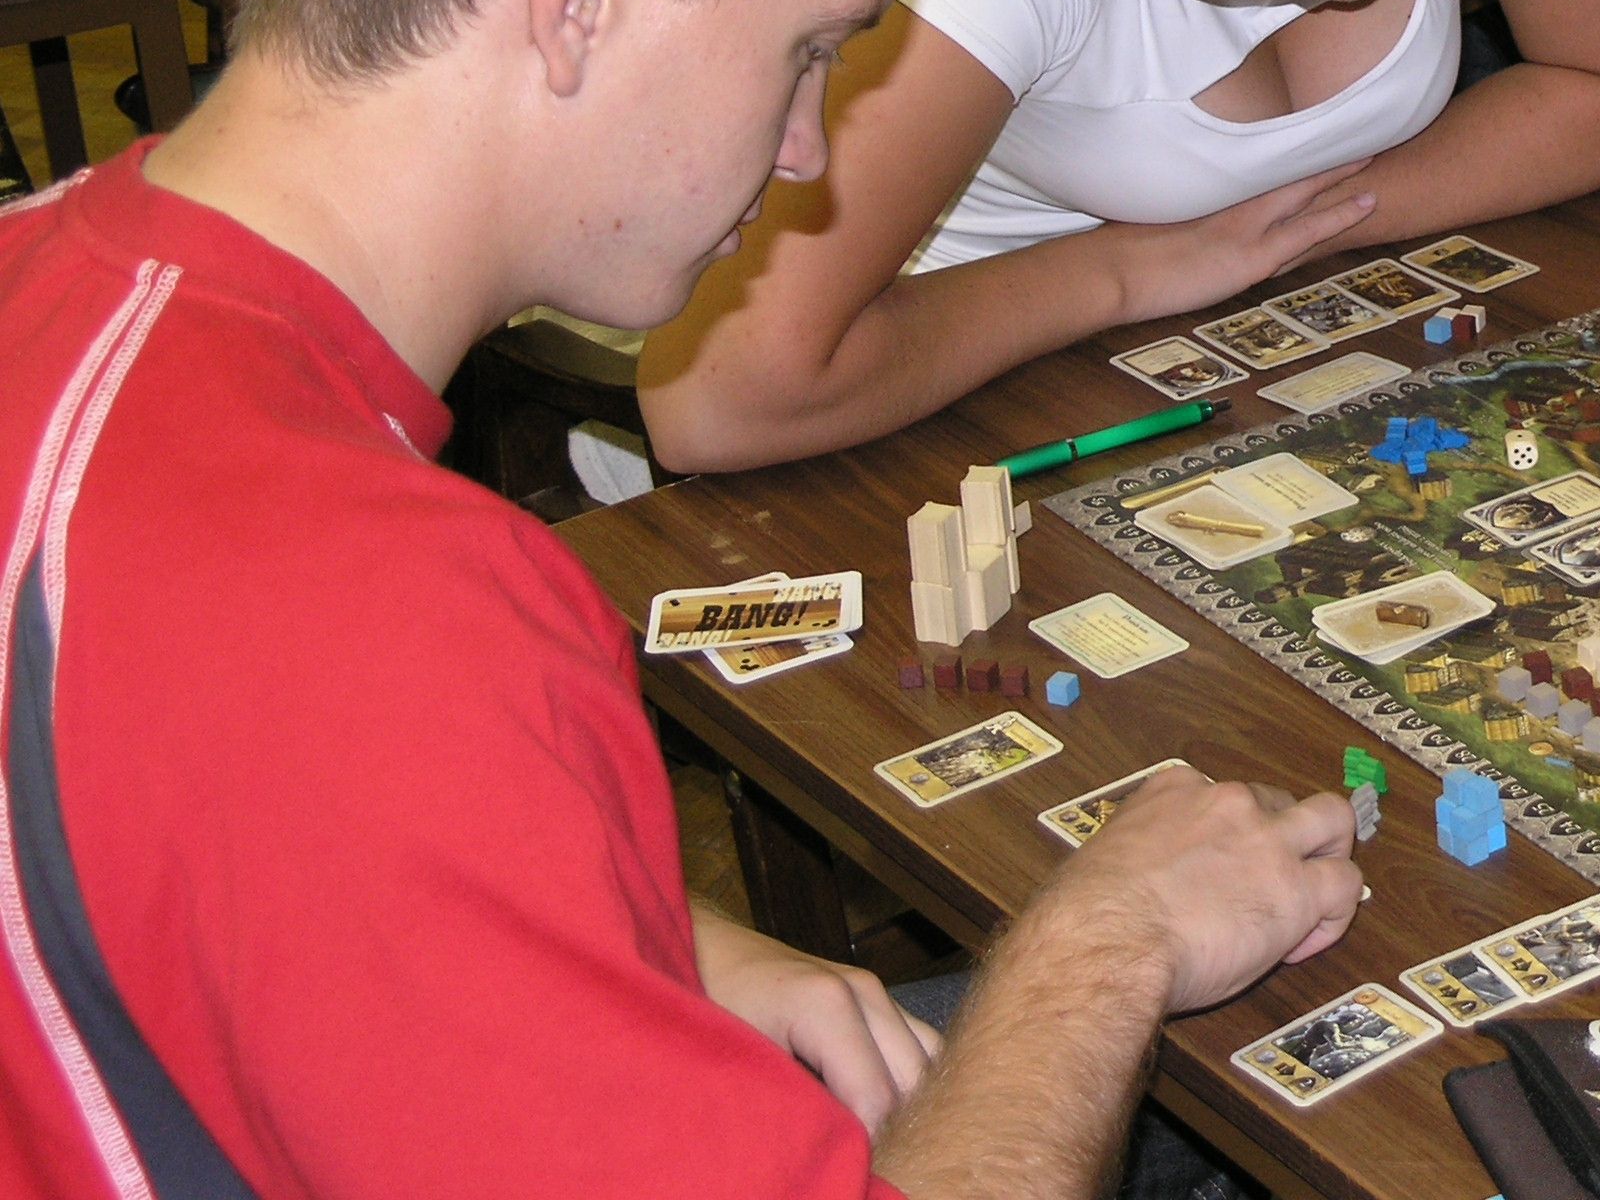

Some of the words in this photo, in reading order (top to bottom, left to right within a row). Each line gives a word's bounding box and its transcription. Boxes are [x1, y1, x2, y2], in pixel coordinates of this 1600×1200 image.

[1155, 469, 1170, 479] 47
[693, 601, 810, 632] BANG!
[1312, 653, 1332, 666] 34
[1335, 670, 1357, 681] 33
[1358, 686, 1379, 698] 32
[1383, 701, 1404, 714] 31
[1406, 716, 1428, 729] 30
[1430, 733, 1452, 747] 29
[1455, 749, 1477, 763] 28
[1509, 784, 1529, 799] 26
[1532, 802, 1555, 814] 25
[1559, 820, 1582, 834] 24
